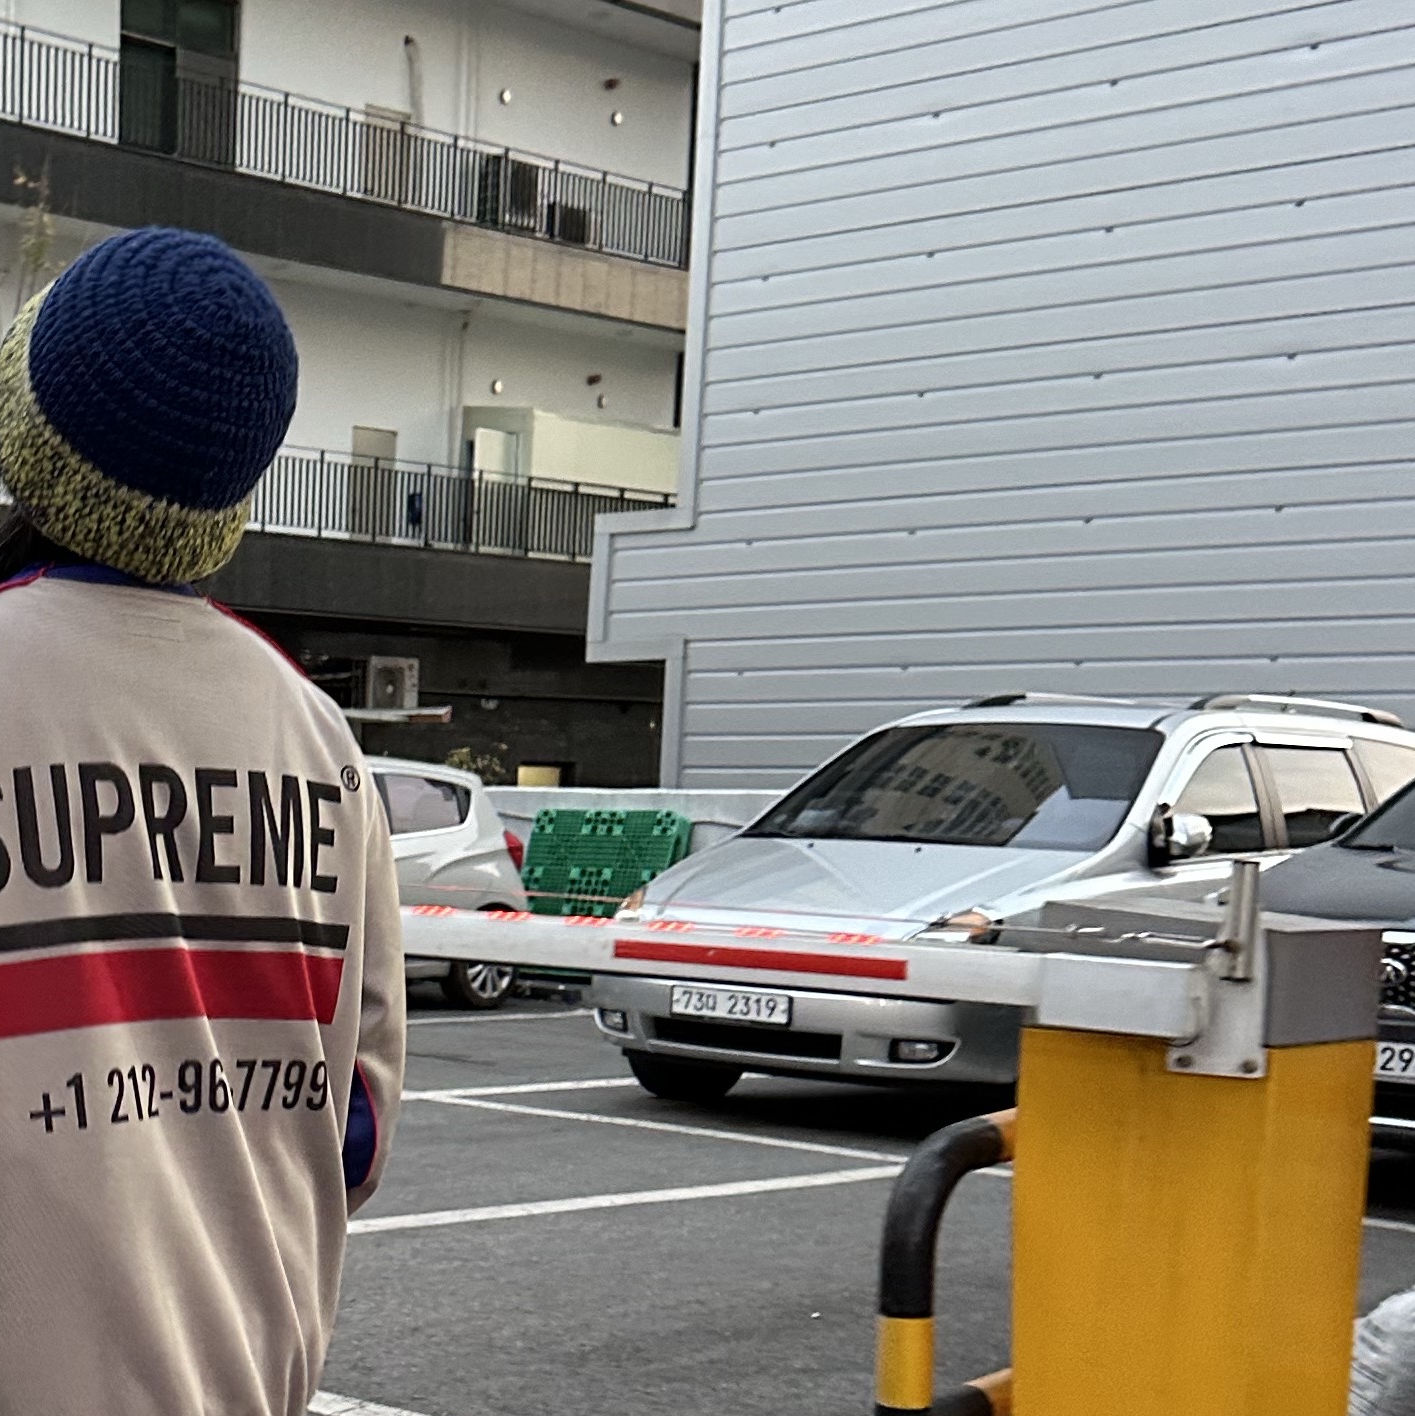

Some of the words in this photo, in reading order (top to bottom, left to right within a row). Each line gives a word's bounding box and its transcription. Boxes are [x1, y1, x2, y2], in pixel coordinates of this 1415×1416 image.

[727, 993, 778, 1018] 2319
[29, 1072, 87, 1133] +1
[107, 1058, 328, 1124] 212-967799
